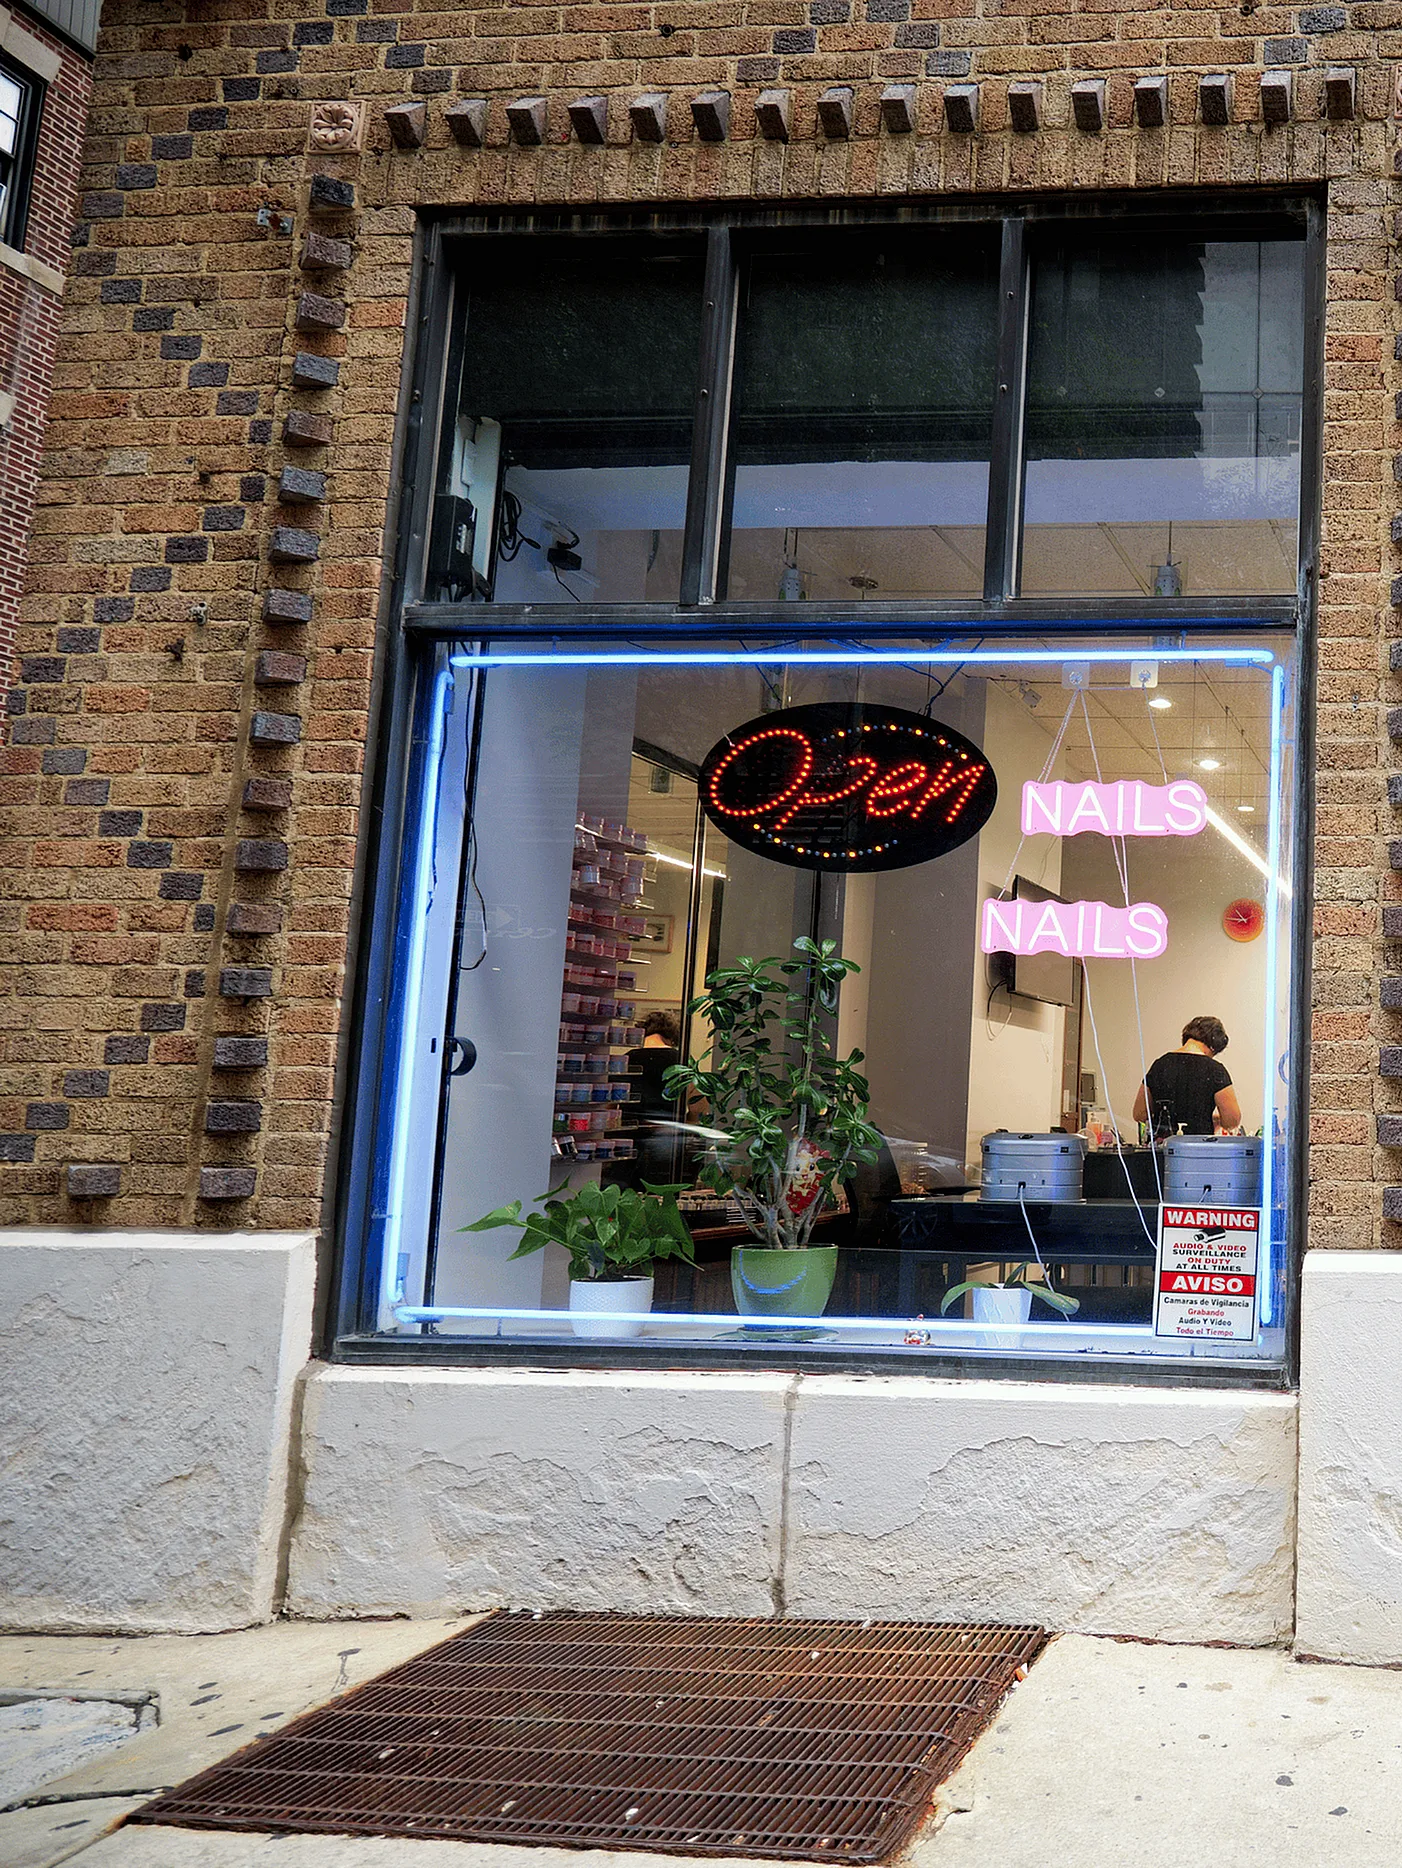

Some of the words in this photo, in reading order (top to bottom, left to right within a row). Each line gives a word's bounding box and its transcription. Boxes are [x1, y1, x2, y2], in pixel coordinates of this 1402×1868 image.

[710, 728, 986, 832] Open
[1024, 783, 1202, 832] NAILS
[984, 904, 1164, 954] NAILS
[1167, 1211, 1255, 1228] WARNING
[1172, 1249, 1247, 1258] SURVEILLANCE
[1173, 1242, 1203, 1250] AUDIO
[1217, 1244, 1247, 1252] VIDEO
[1172, 1276, 1243, 1292] AVISO
[1164, 1297, 1198, 1305] Camaras
[1211, 1298, 1250, 1308] Vigilancia
[1188, 1308, 1225, 1316] Grabando
[1176, 1327, 1195, 1335] Todo
[1196, 1327, 1204, 1335] el
[1205, 1328, 1234, 1337] Tiempo
